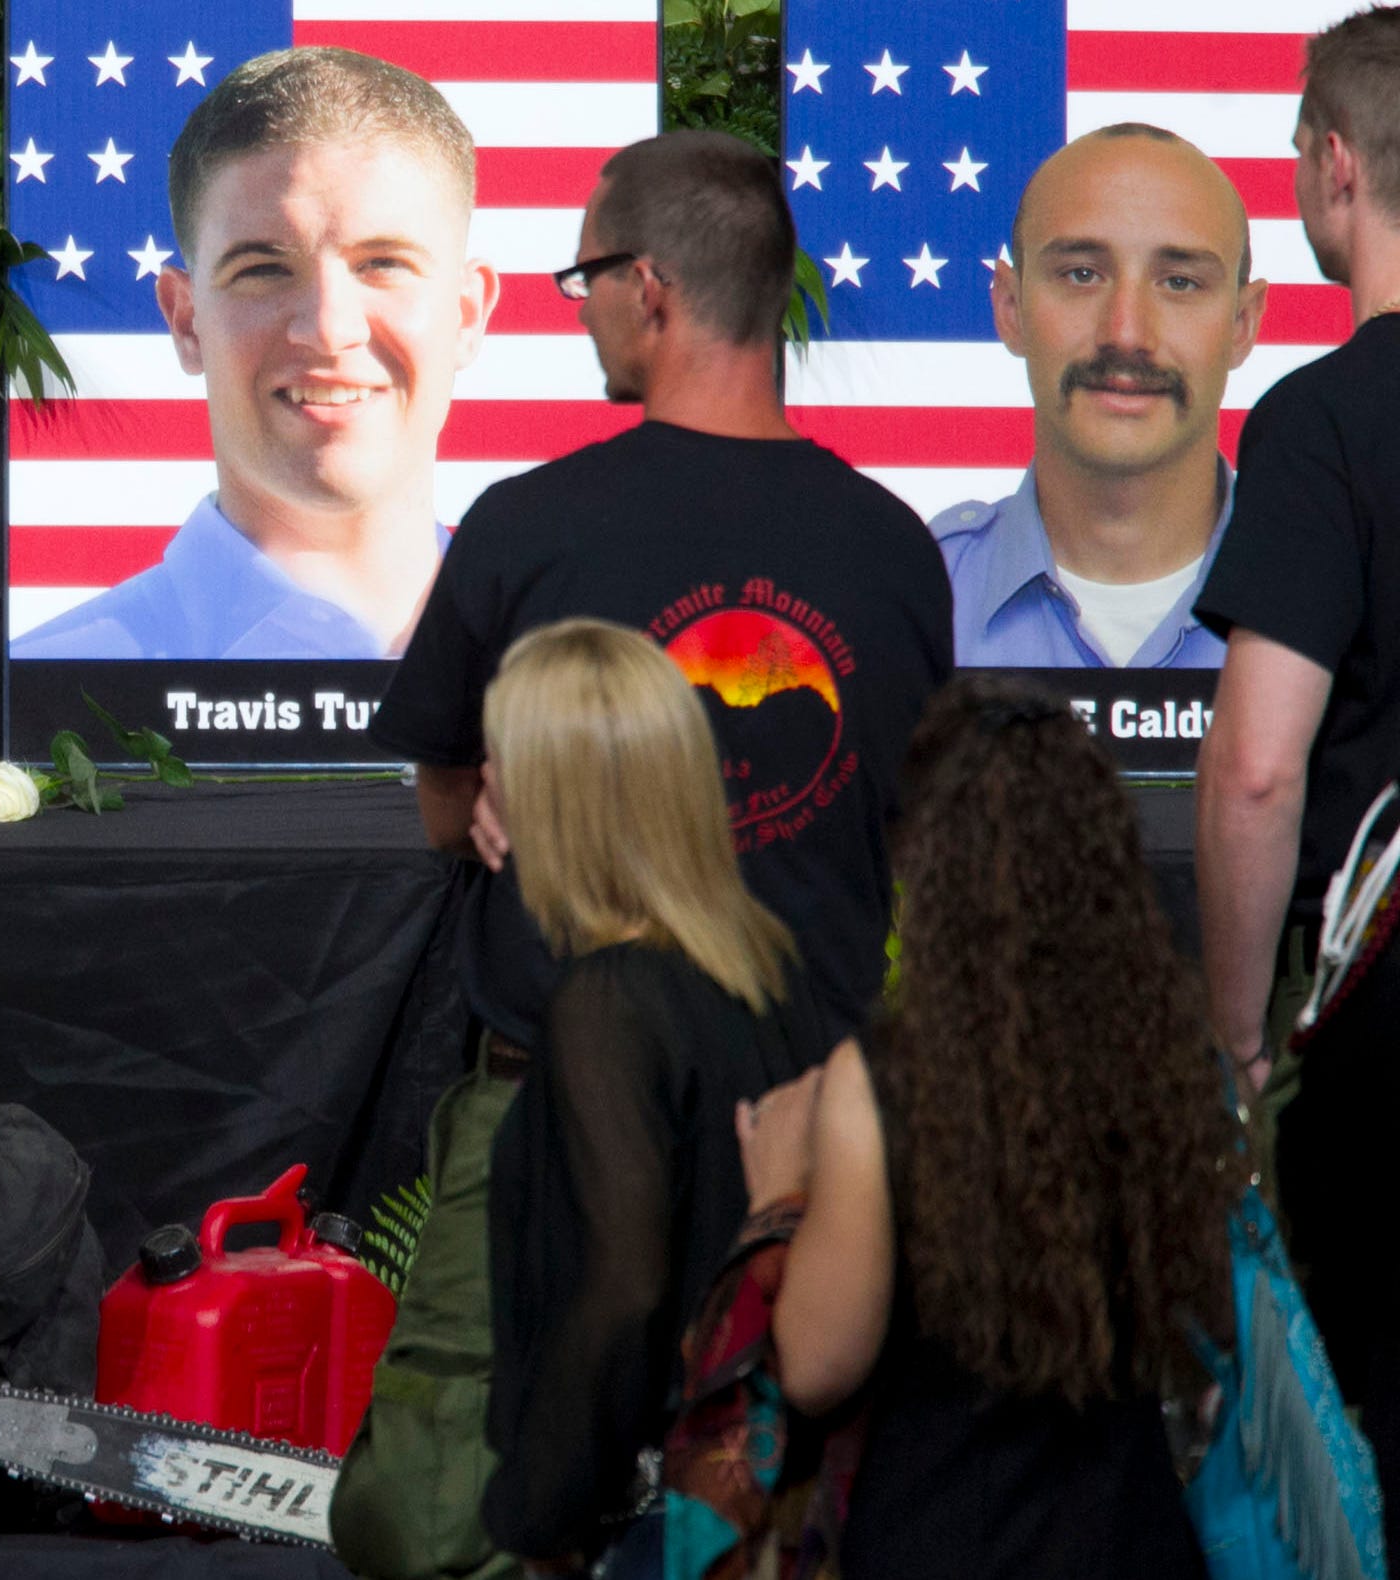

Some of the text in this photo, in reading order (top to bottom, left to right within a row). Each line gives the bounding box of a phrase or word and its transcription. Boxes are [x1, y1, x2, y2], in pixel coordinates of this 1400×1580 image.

[642, 576, 856, 677] ranite Mountain
[166, 692, 381, 730] Travis Tu
[163, 1450, 321, 1519] STIHL
